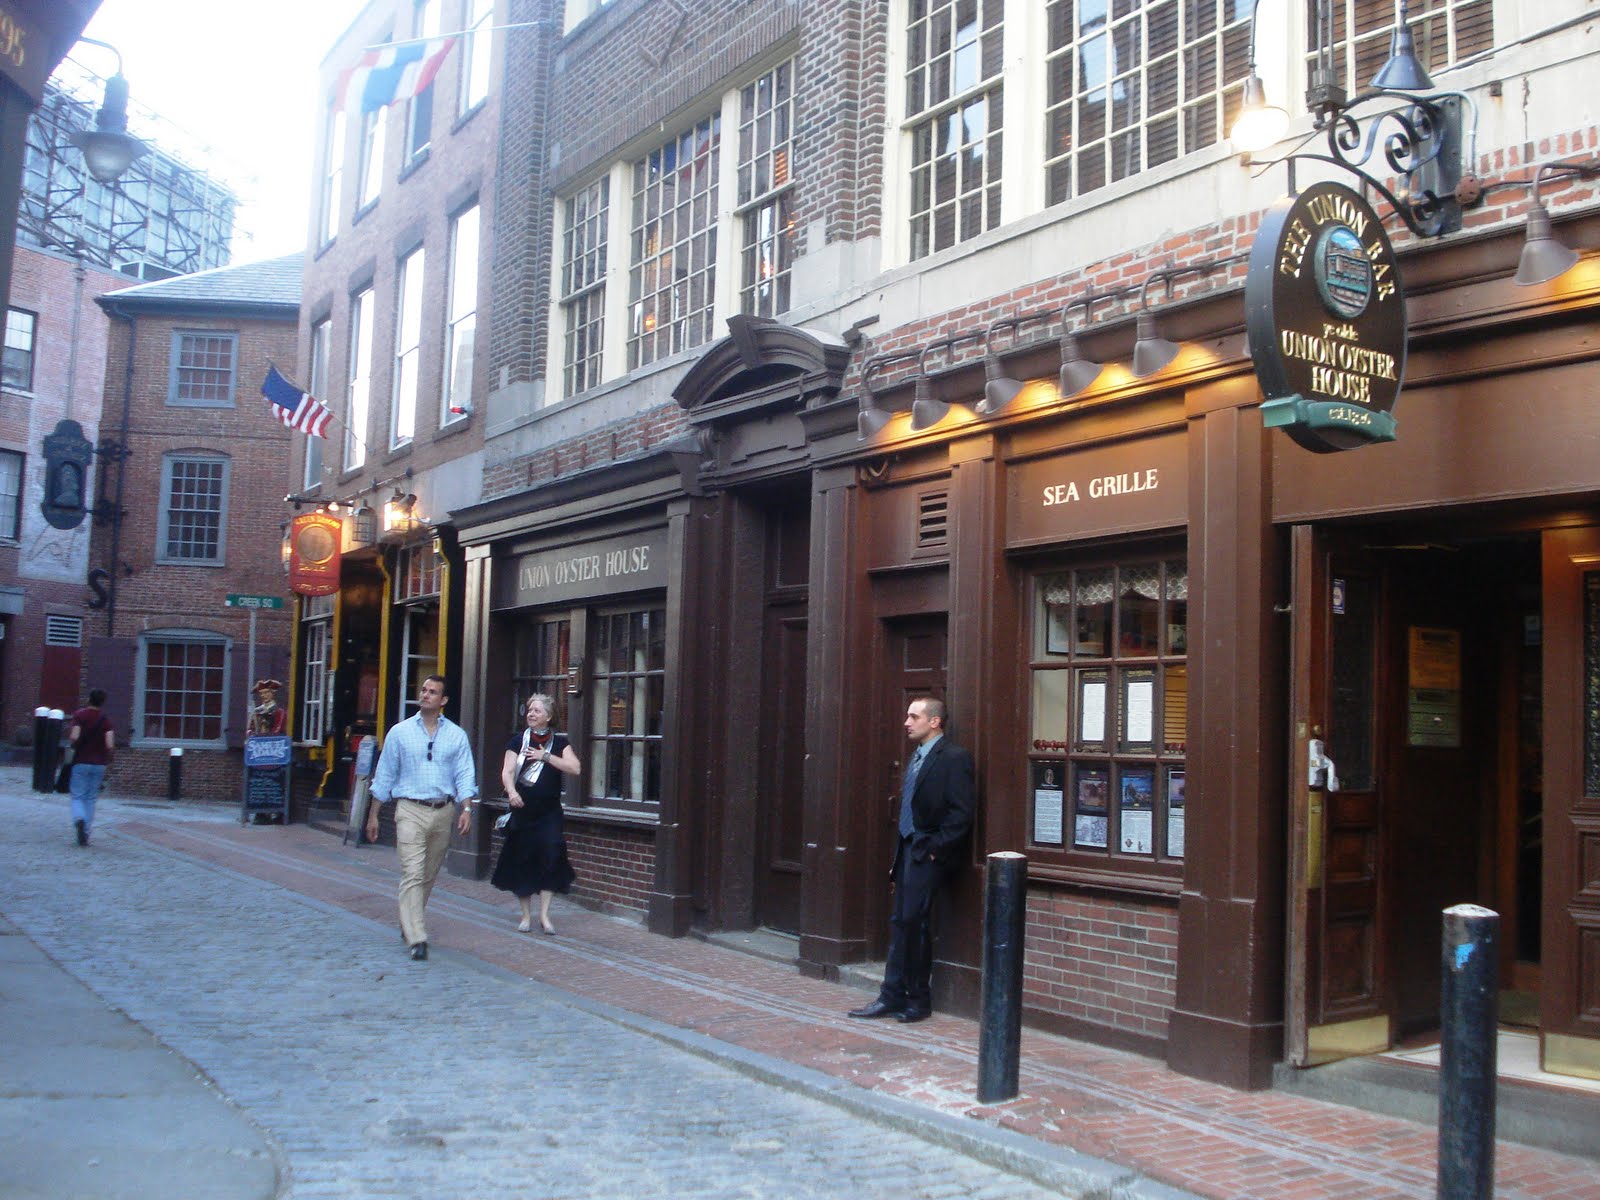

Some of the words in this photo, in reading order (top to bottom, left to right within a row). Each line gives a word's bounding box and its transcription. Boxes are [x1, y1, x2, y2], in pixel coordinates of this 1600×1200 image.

[0, 8, 26, 67] 95
[1280, 219, 1311, 278] THE
[1306, 193, 1370, 238] UNION
[1365, 240, 1396, 302] BAR
[1281, 329, 1337, 367] UNION
[1338, 343, 1398, 381] OYSTER
[1311, 366, 1371, 403] HOUSE
[1043, 481, 1080, 506] SEA
[1088, 468, 1159, 498] GRILLE
[519, 565, 550, 591] UNION
[555, 555, 600, 584] OYSTER
[605, 546, 650, 577] HOUSE
[238, 597, 260, 608] CREEK
[248, 740, 288, 752] SAMUEL
